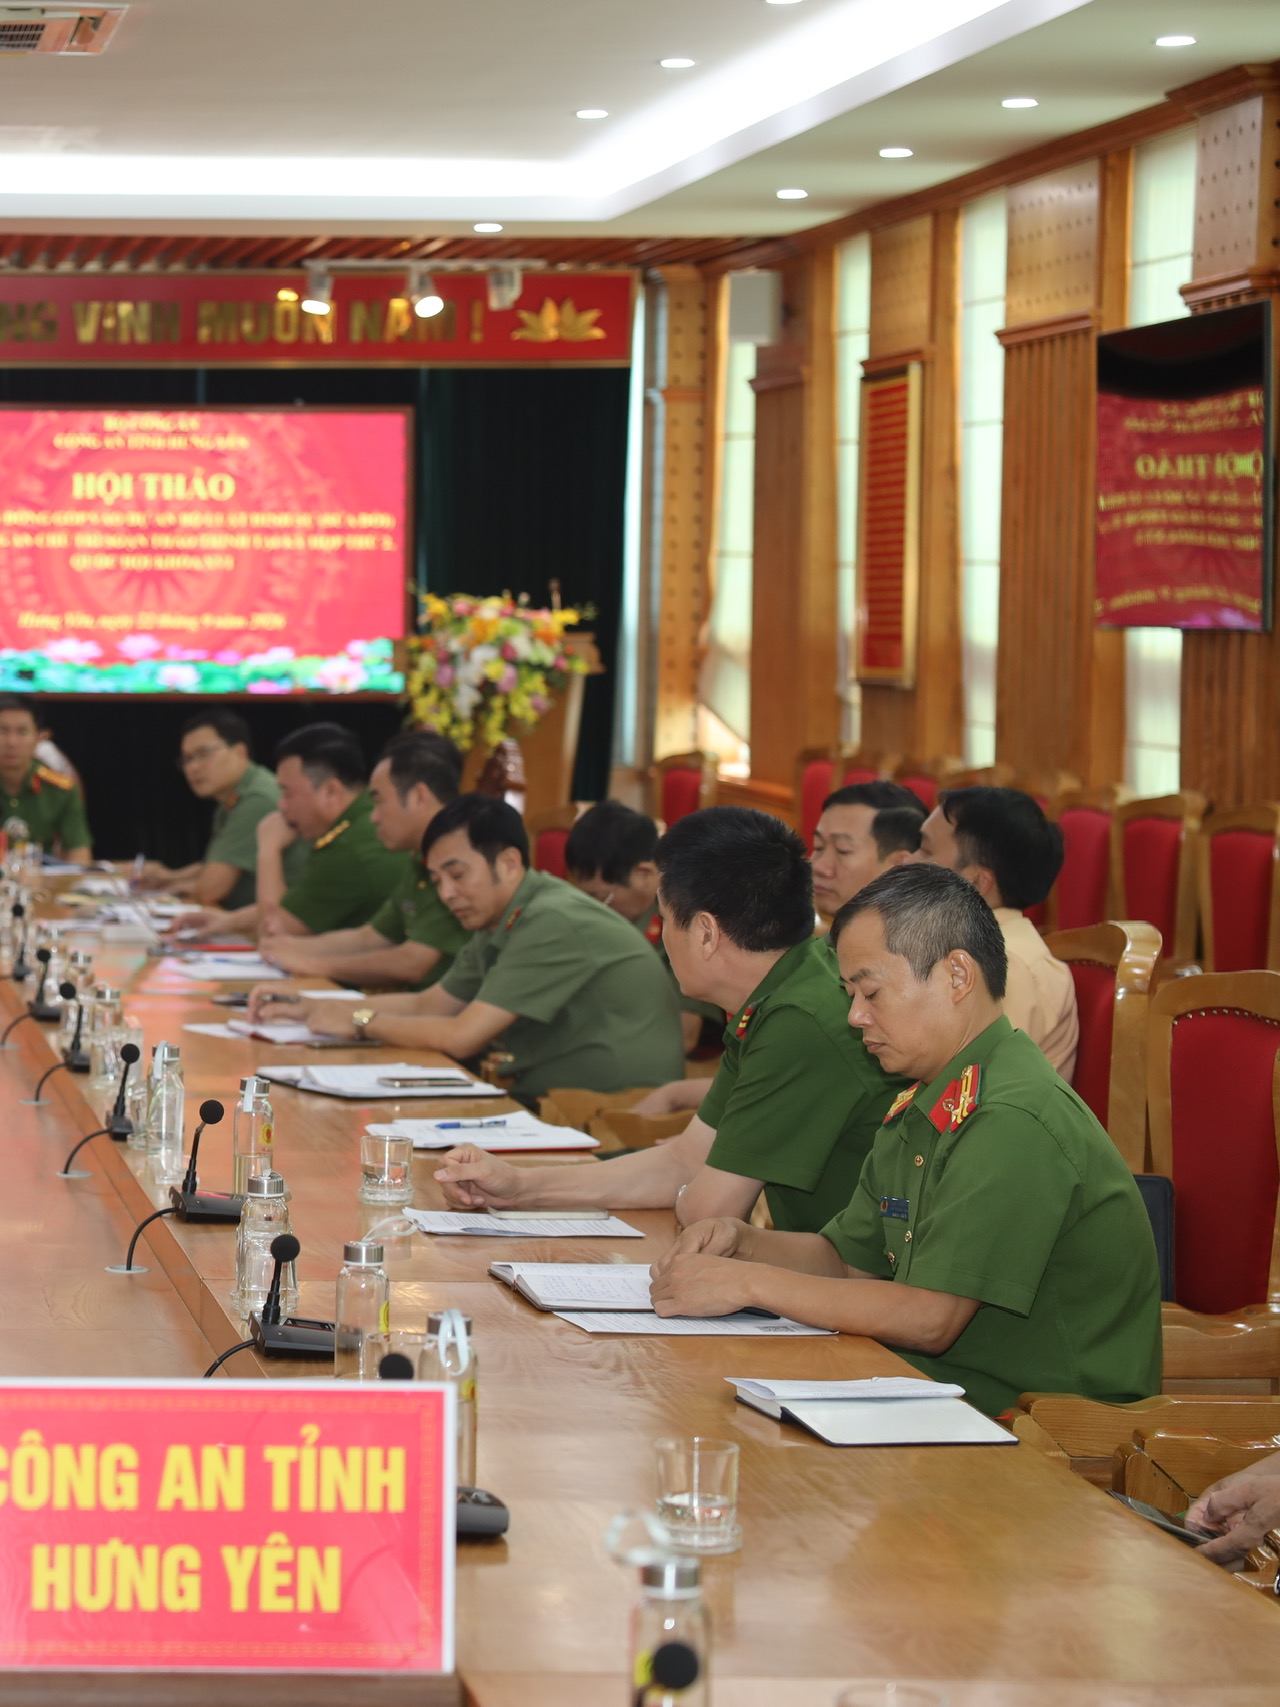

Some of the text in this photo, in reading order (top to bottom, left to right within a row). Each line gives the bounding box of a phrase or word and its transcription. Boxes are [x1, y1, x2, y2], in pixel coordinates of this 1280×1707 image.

[73, 300, 180, 344] VINH
[197, 289, 337, 344] MUÔN
[72, 467, 236, 505] HỘI THẢO
[157, 1444, 245, 1511] AN
[264, 1423, 407, 1514] TỈNH
[30, 1531, 342, 1614] HƯNG YÊN
